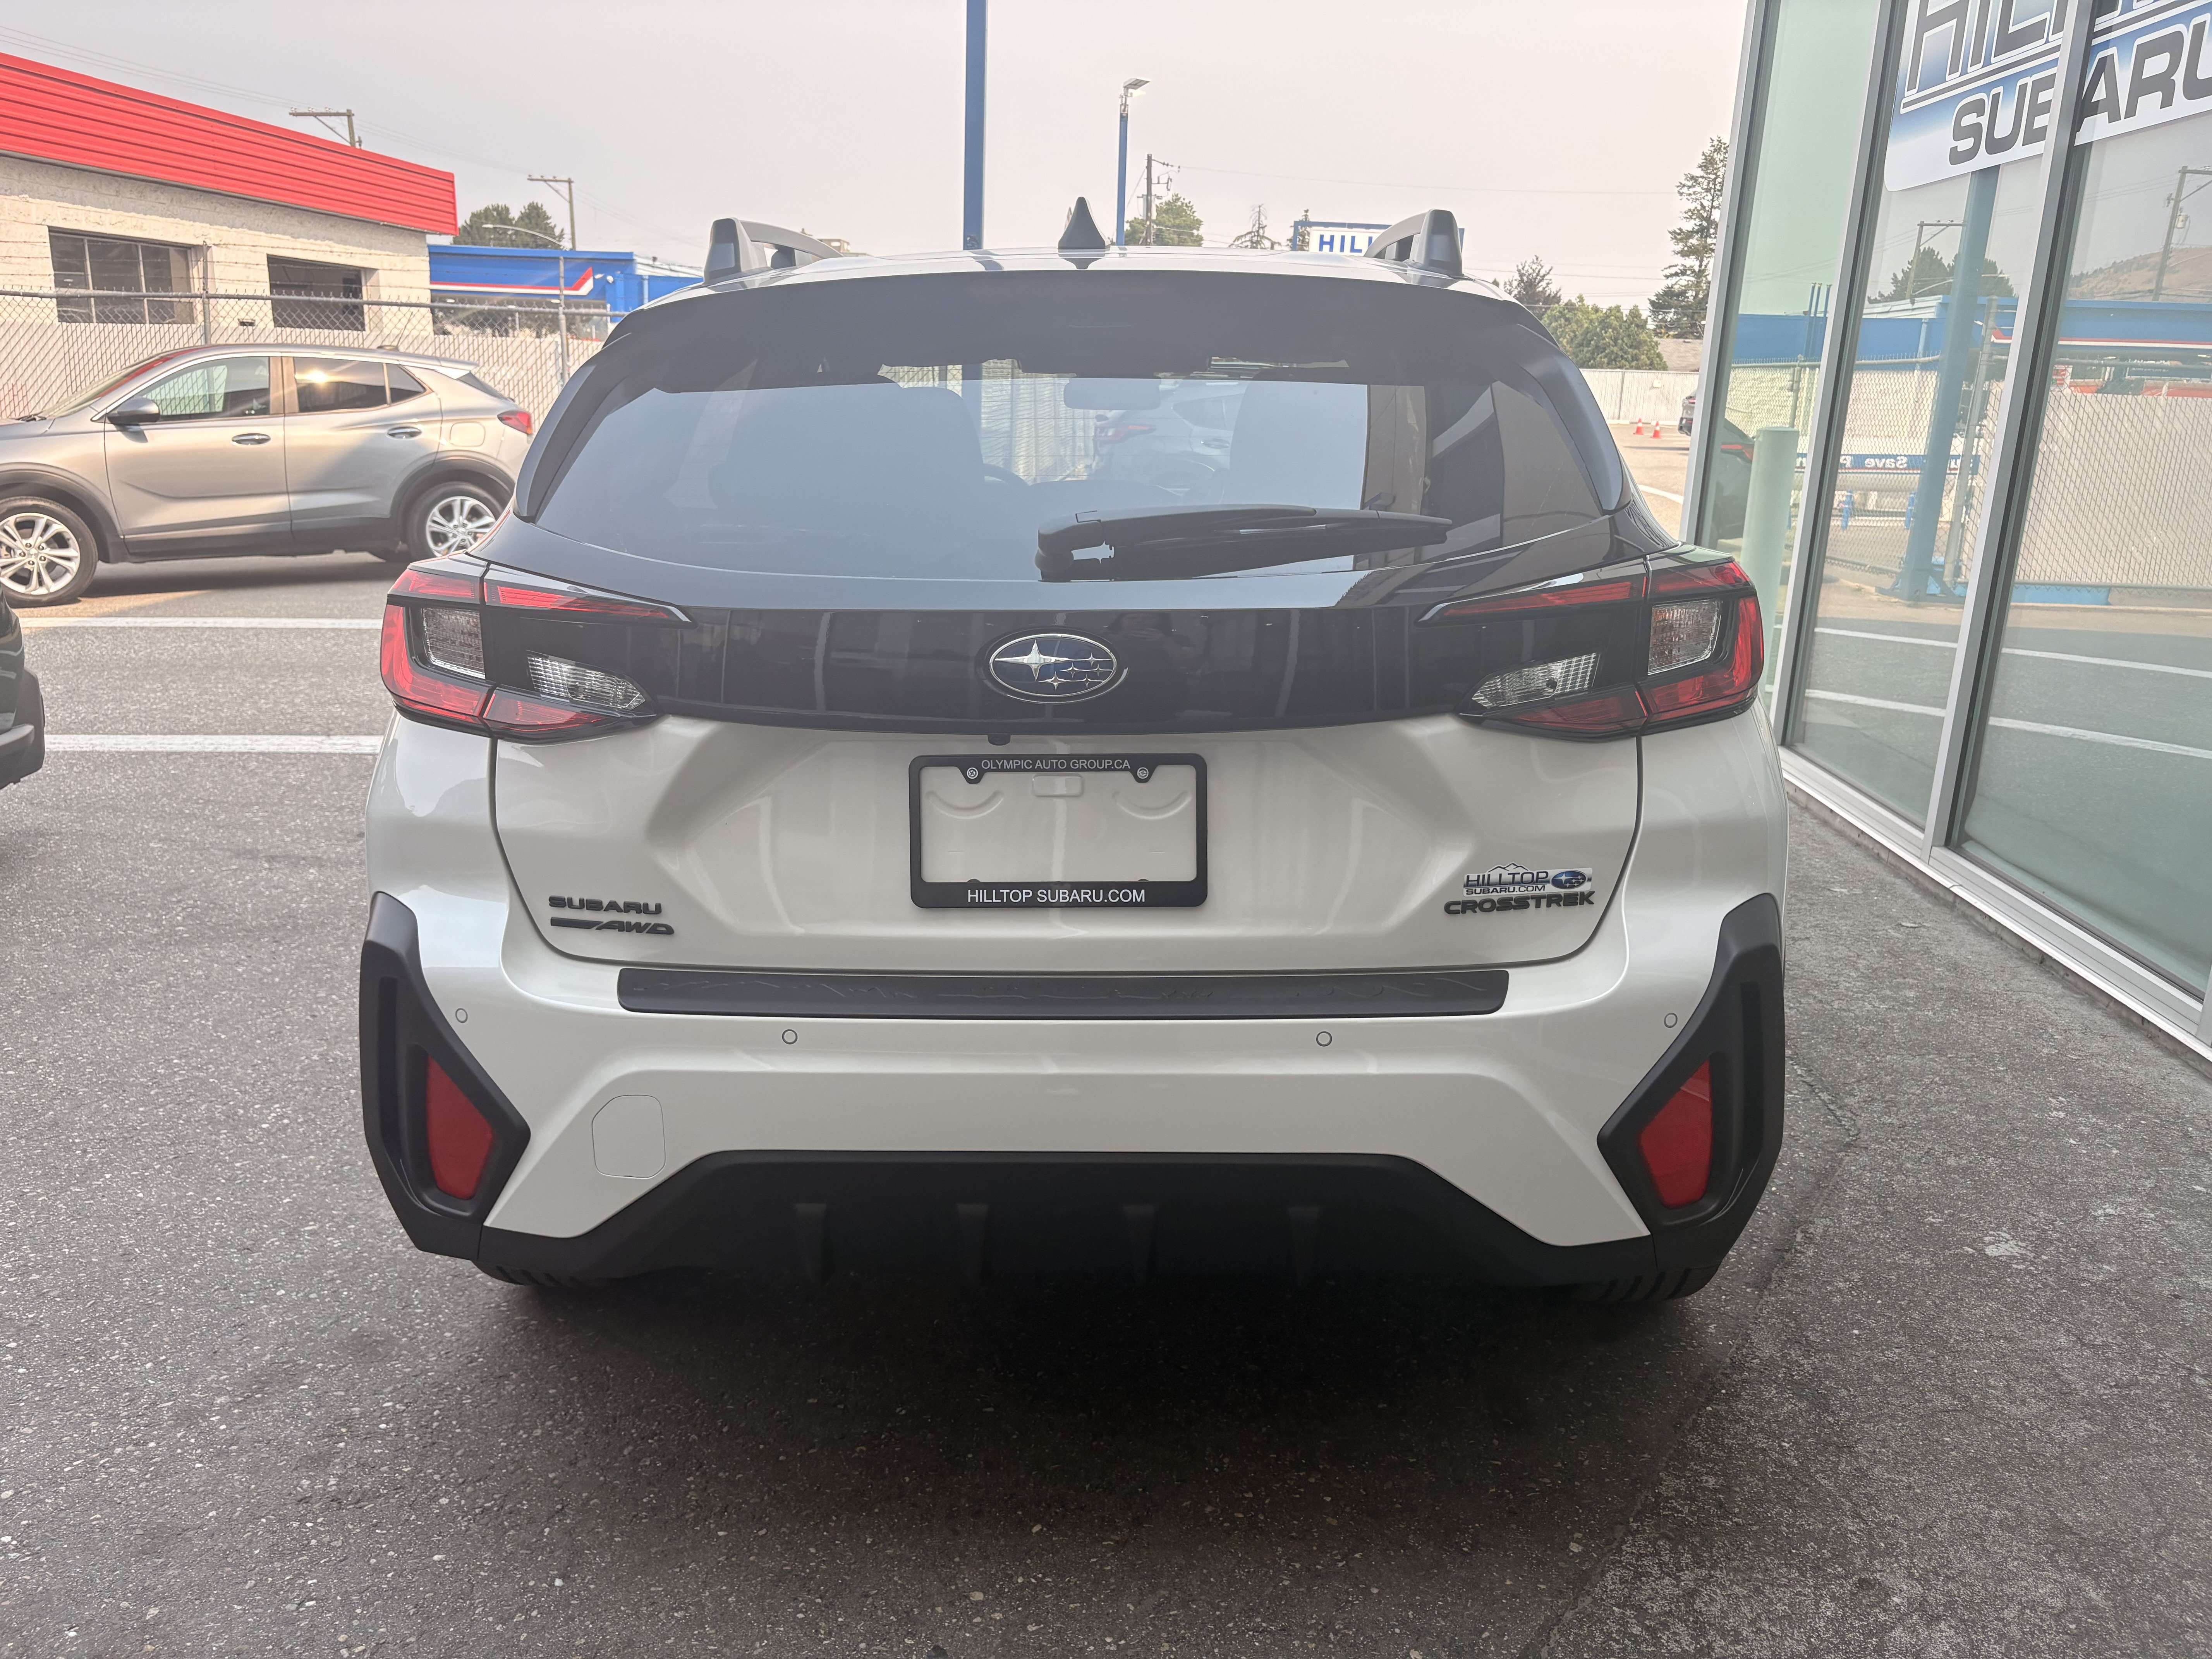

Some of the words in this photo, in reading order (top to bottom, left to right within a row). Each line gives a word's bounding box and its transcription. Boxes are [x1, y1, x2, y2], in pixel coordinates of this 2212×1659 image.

[981, 759, 1032, 769] OLYMPIC
[1034, 759, 1067, 769] AUTO
[1070, 759, 1131, 769] GROUP.CA
[1466, 871, 1548, 887] HILLTOP
[967, 890, 1033, 902] HILLTOP
[1037, 889, 1145, 903] SUBARU.COM
[1466, 885, 1545, 895] SUBARU.COM
[548, 895, 662, 915] SUBARU
[1444, 890, 1595, 915] CROSSTREK
[595, 920, 675, 935] AWD
